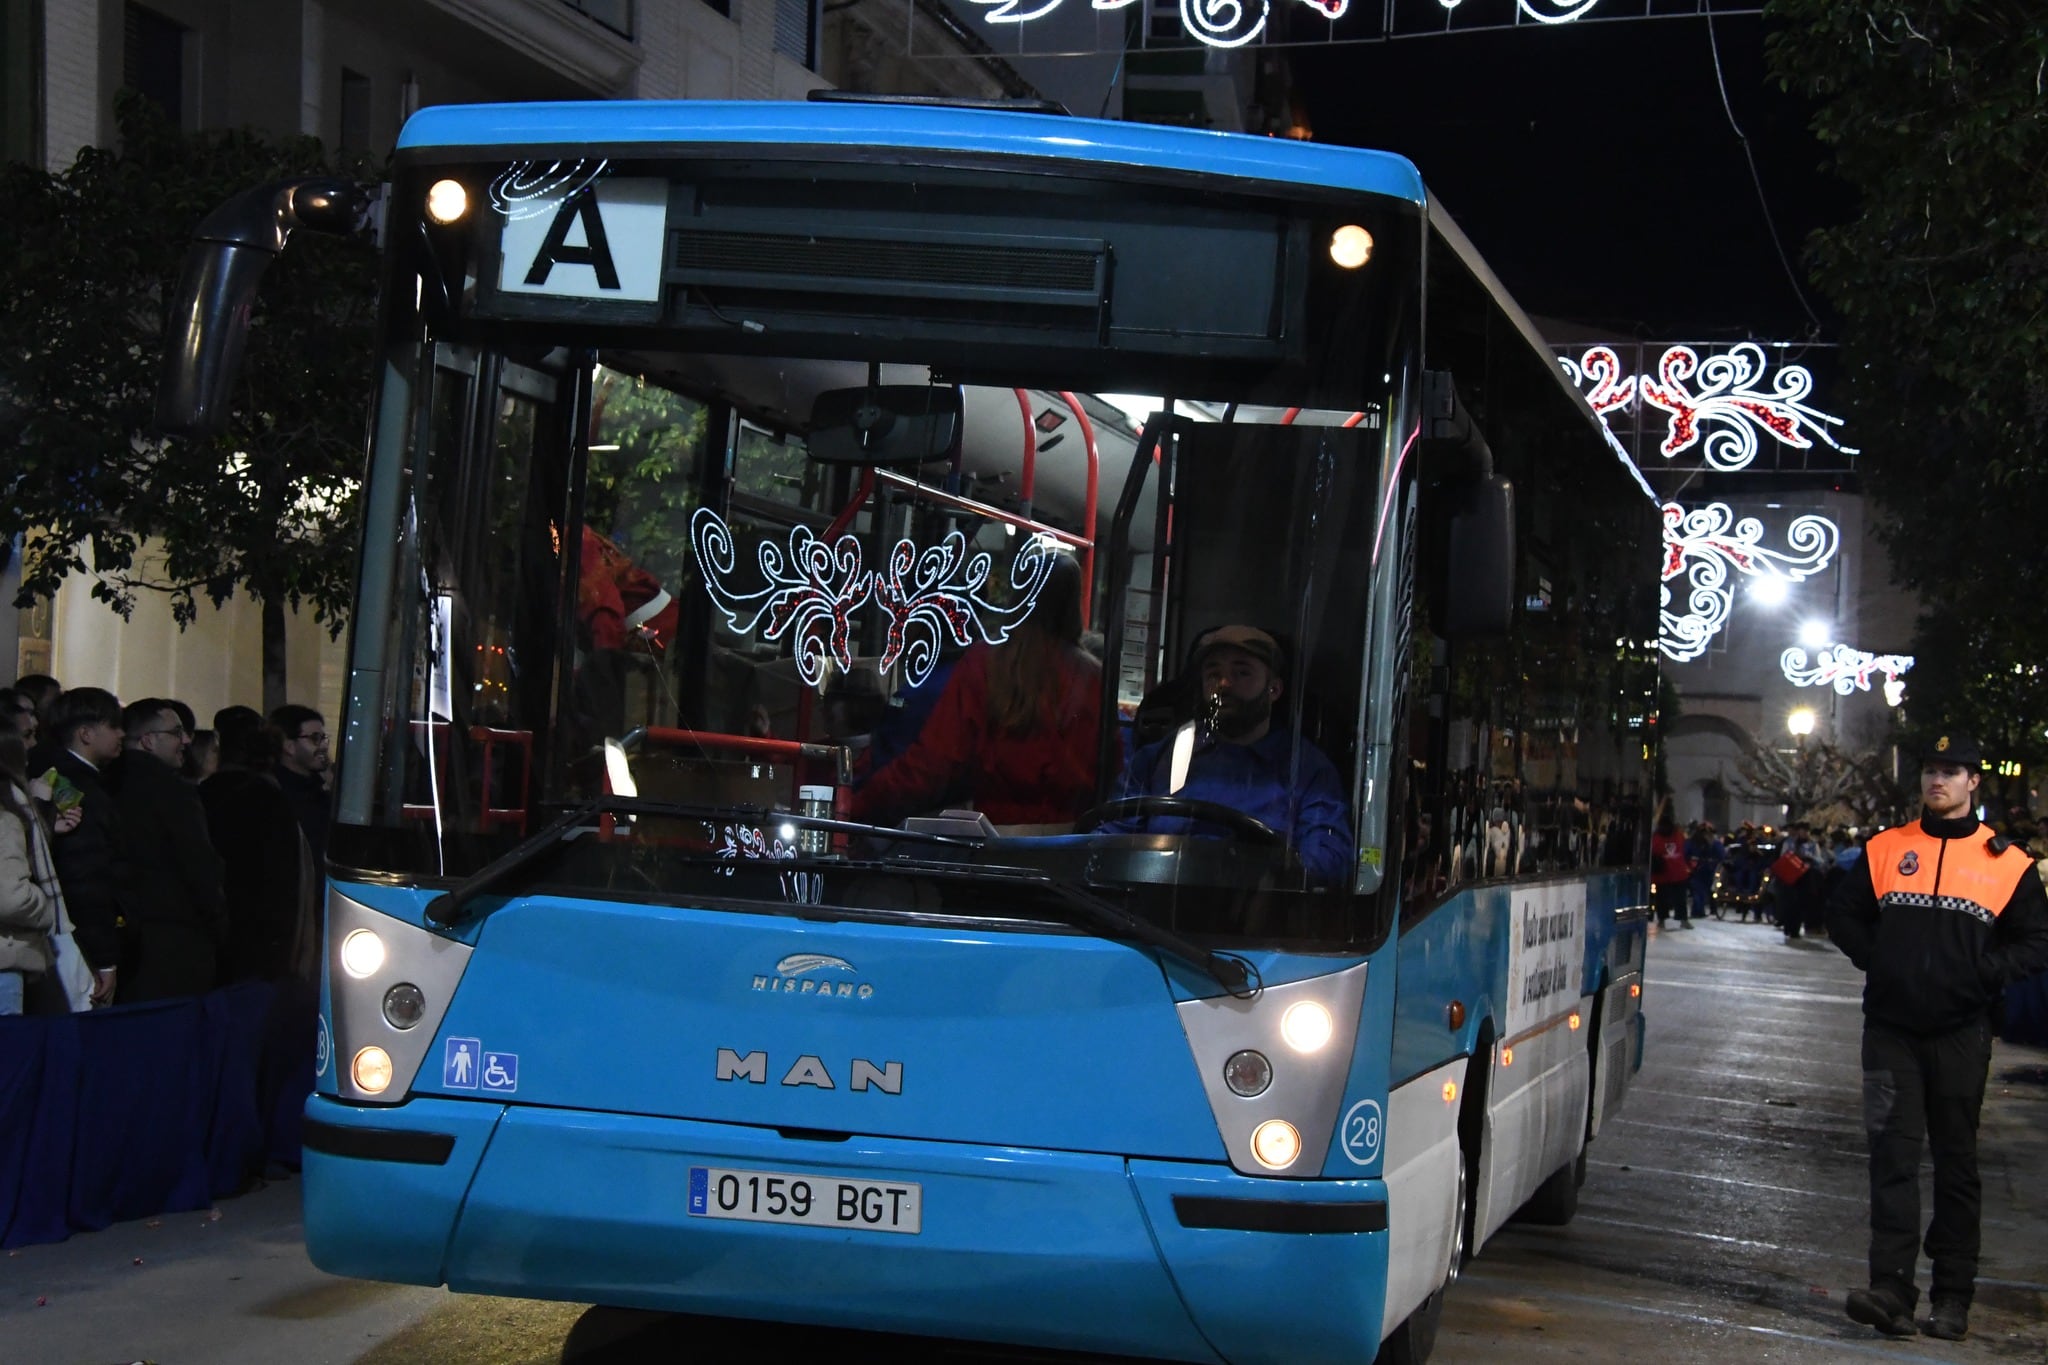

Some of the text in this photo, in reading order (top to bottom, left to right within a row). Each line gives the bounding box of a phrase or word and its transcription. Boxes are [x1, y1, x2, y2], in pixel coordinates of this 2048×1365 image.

[524, 183, 621, 290] A
[752, 975, 874, 998] HISPANO
[716, 1048, 903, 1095] MAN
[1350, 1116, 1378, 1148] 28
[694, 1174, 908, 1225] E 0159 BGT
